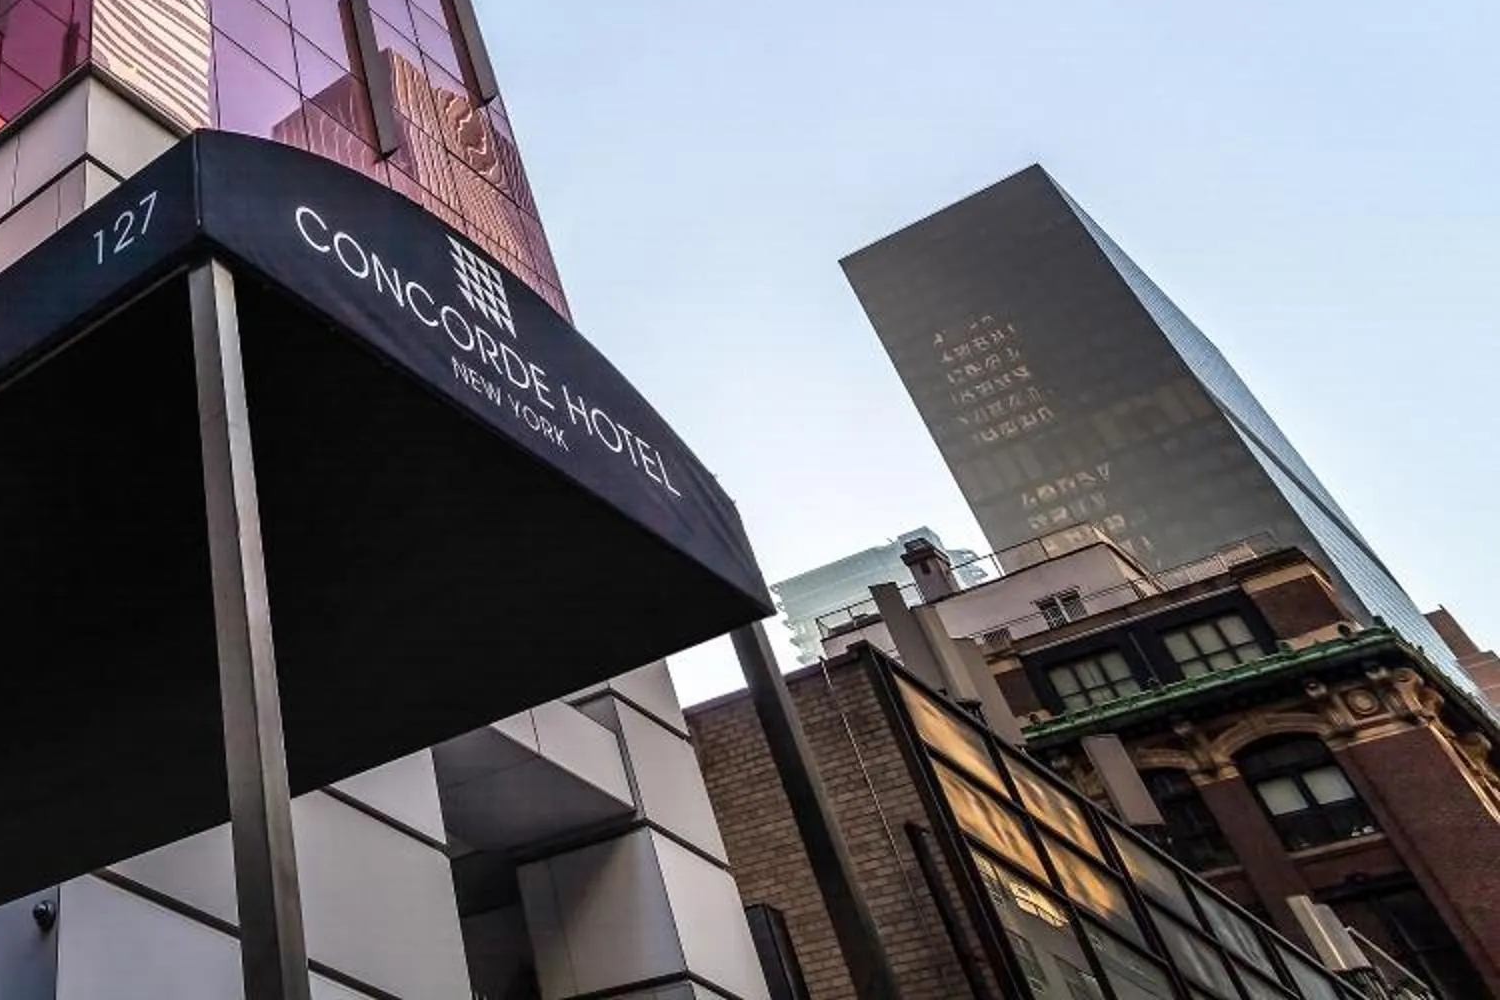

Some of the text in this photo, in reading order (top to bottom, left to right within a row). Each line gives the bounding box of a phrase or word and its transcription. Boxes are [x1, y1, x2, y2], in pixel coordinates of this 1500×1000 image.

[93, 191, 157, 265] 127
[295, 205, 682, 497] CONCORDE HOTEL
[451, 355, 570, 452] NEW YORK
